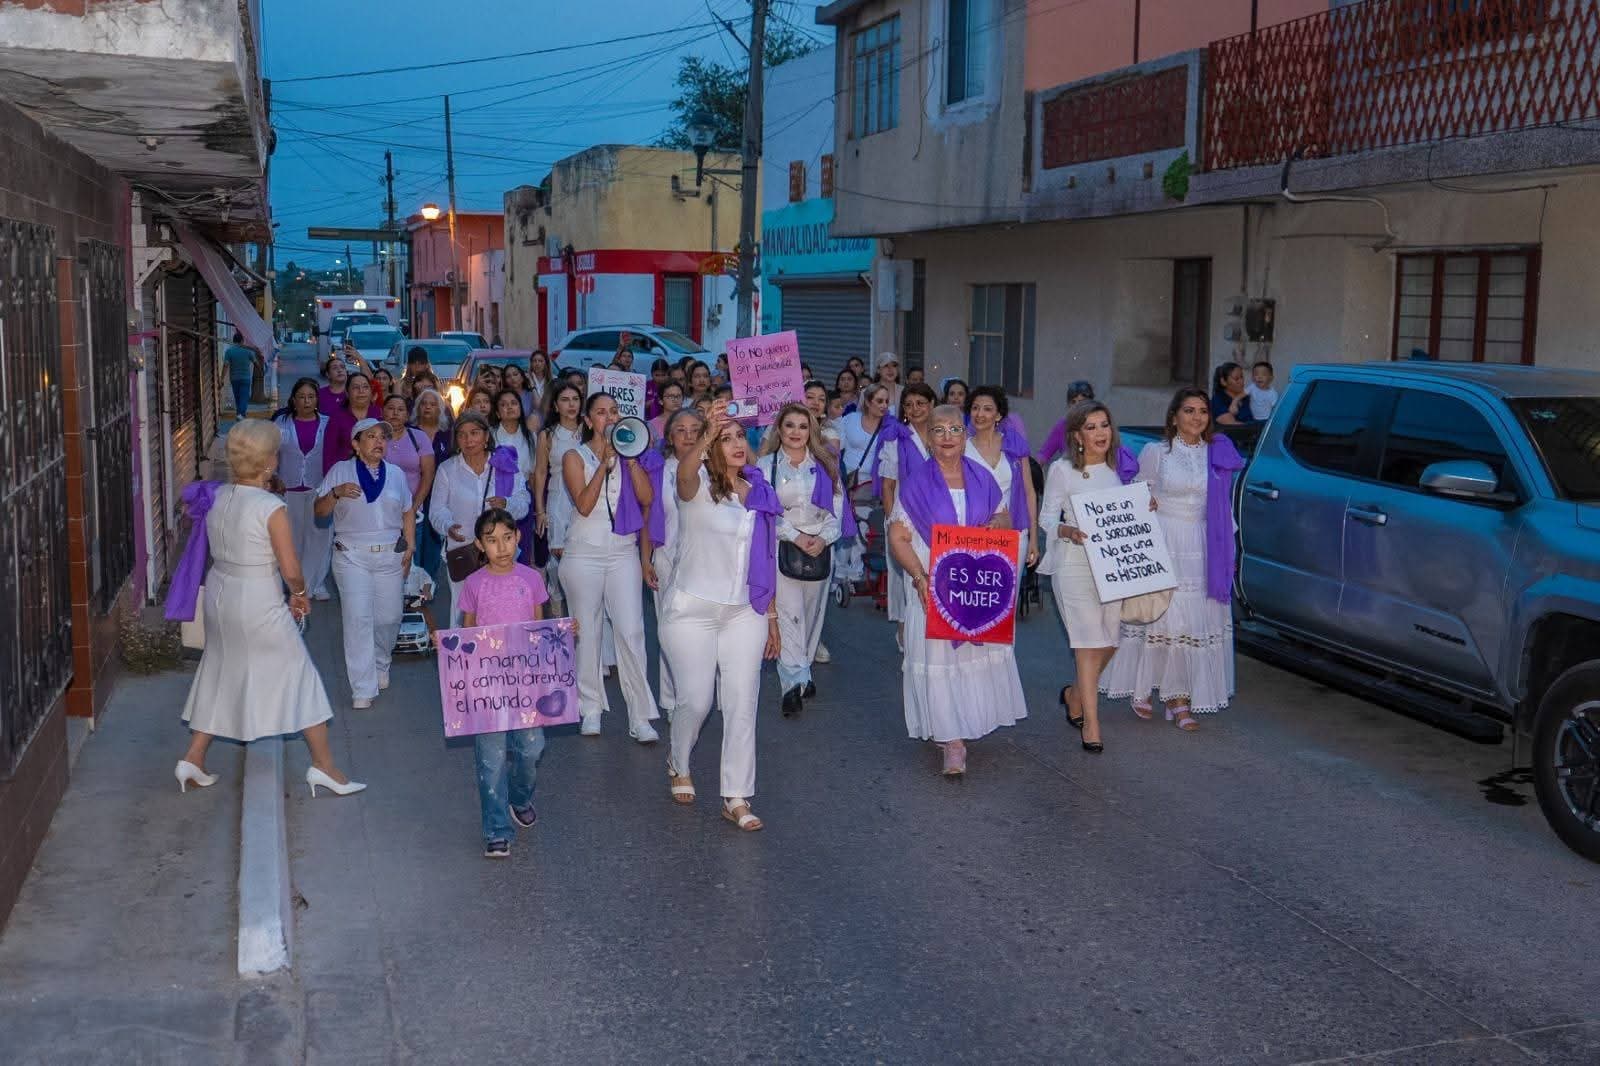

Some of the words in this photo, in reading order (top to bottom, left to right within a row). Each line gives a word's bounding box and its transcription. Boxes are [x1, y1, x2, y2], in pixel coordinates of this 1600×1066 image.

[731, 346, 745, 359] Yo
[749, 347, 763, 359] NO
[744, 380, 753, 394] Yo
[1084, 502, 1104, 516] No
[1106, 502, 1118, 511] es
[1120, 500, 1134, 509] un
[937, 530, 951, 545] Mi
[955, 535, 982, 547] super
[985, 536, 1010, 548] poder
[1091, 533, 1103, 543] es
[1105, 523, 1151, 540] SORORIDAD
[1100, 544, 1119, 559] No
[1120, 543, 1133, 554] es
[1134, 539, 1153, 549] una
[950, 567, 969, 583] ES
[975, 569, 1004, 588] SER
[1105, 572, 1118, 583] es
[949, 590, 1001, 608] MUJER
[447, 653, 469, 671] Mi
[545, 652, 557, 677] y
[450, 678, 465, 697] yo
[472, 670, 575, 687] cambiaremos
[455, 694, 469, 714] el
[473, 687, 533, 711] mundo
